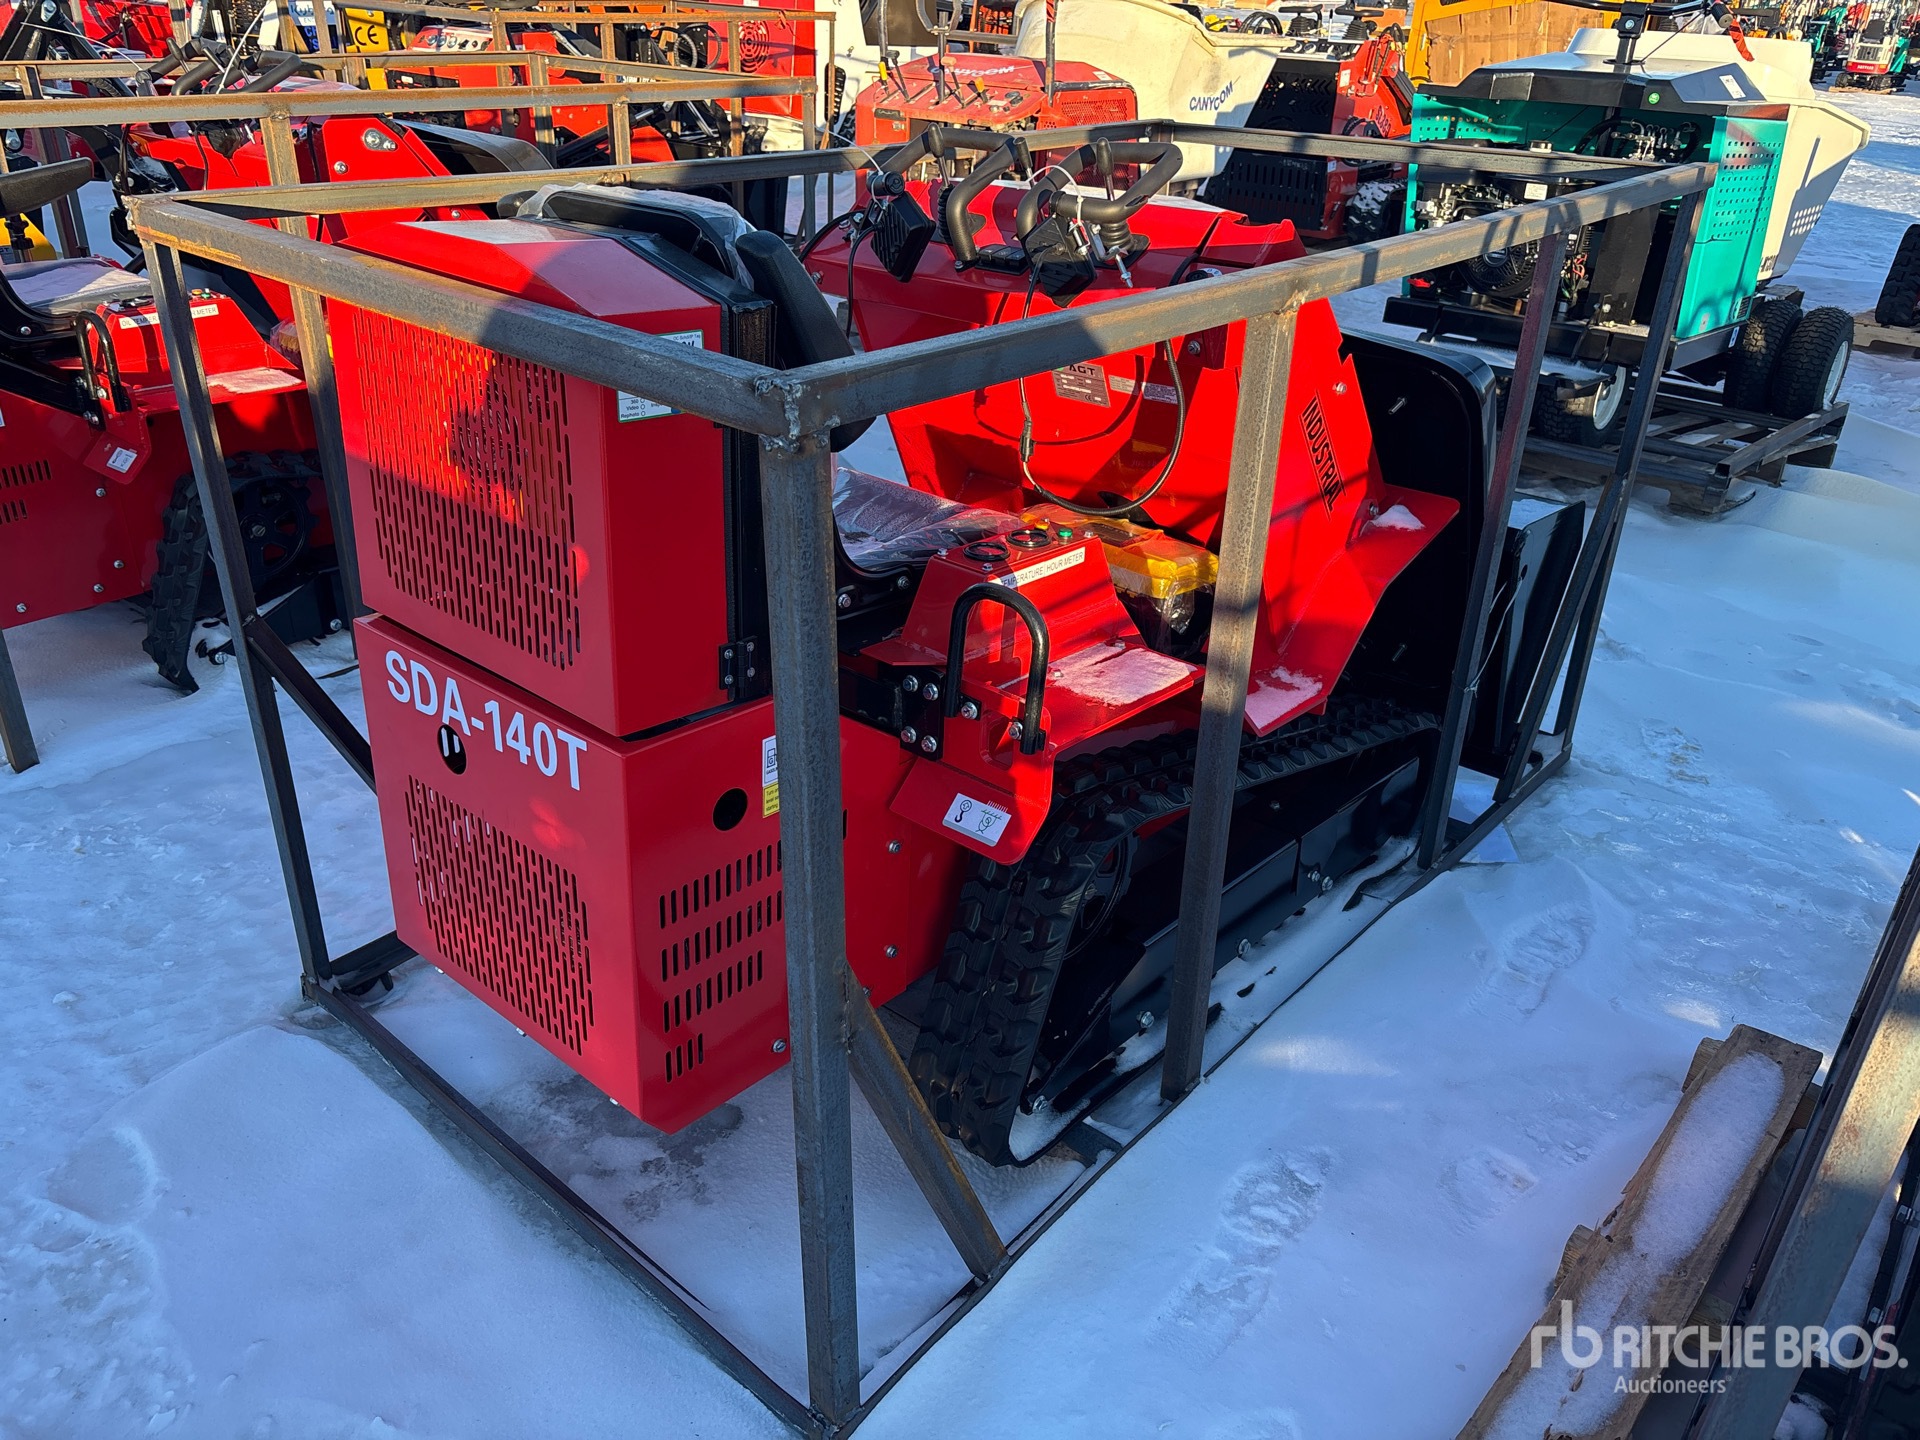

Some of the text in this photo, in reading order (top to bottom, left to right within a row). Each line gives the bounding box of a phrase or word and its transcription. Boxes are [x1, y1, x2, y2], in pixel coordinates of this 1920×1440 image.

[1189, 80, 1233, 111] CANYCOM
[121, 315, 158, 327] OIL TEMPER
[197, 307, 217, 315] METER
[1069, 364, 1096, 376] AGT
[1302, 396, 1343, 512] INDUSTRIAL
[1046, 551, 1084, 573] HOUR METER
[385, 650, 588, 791] SDA-140T
